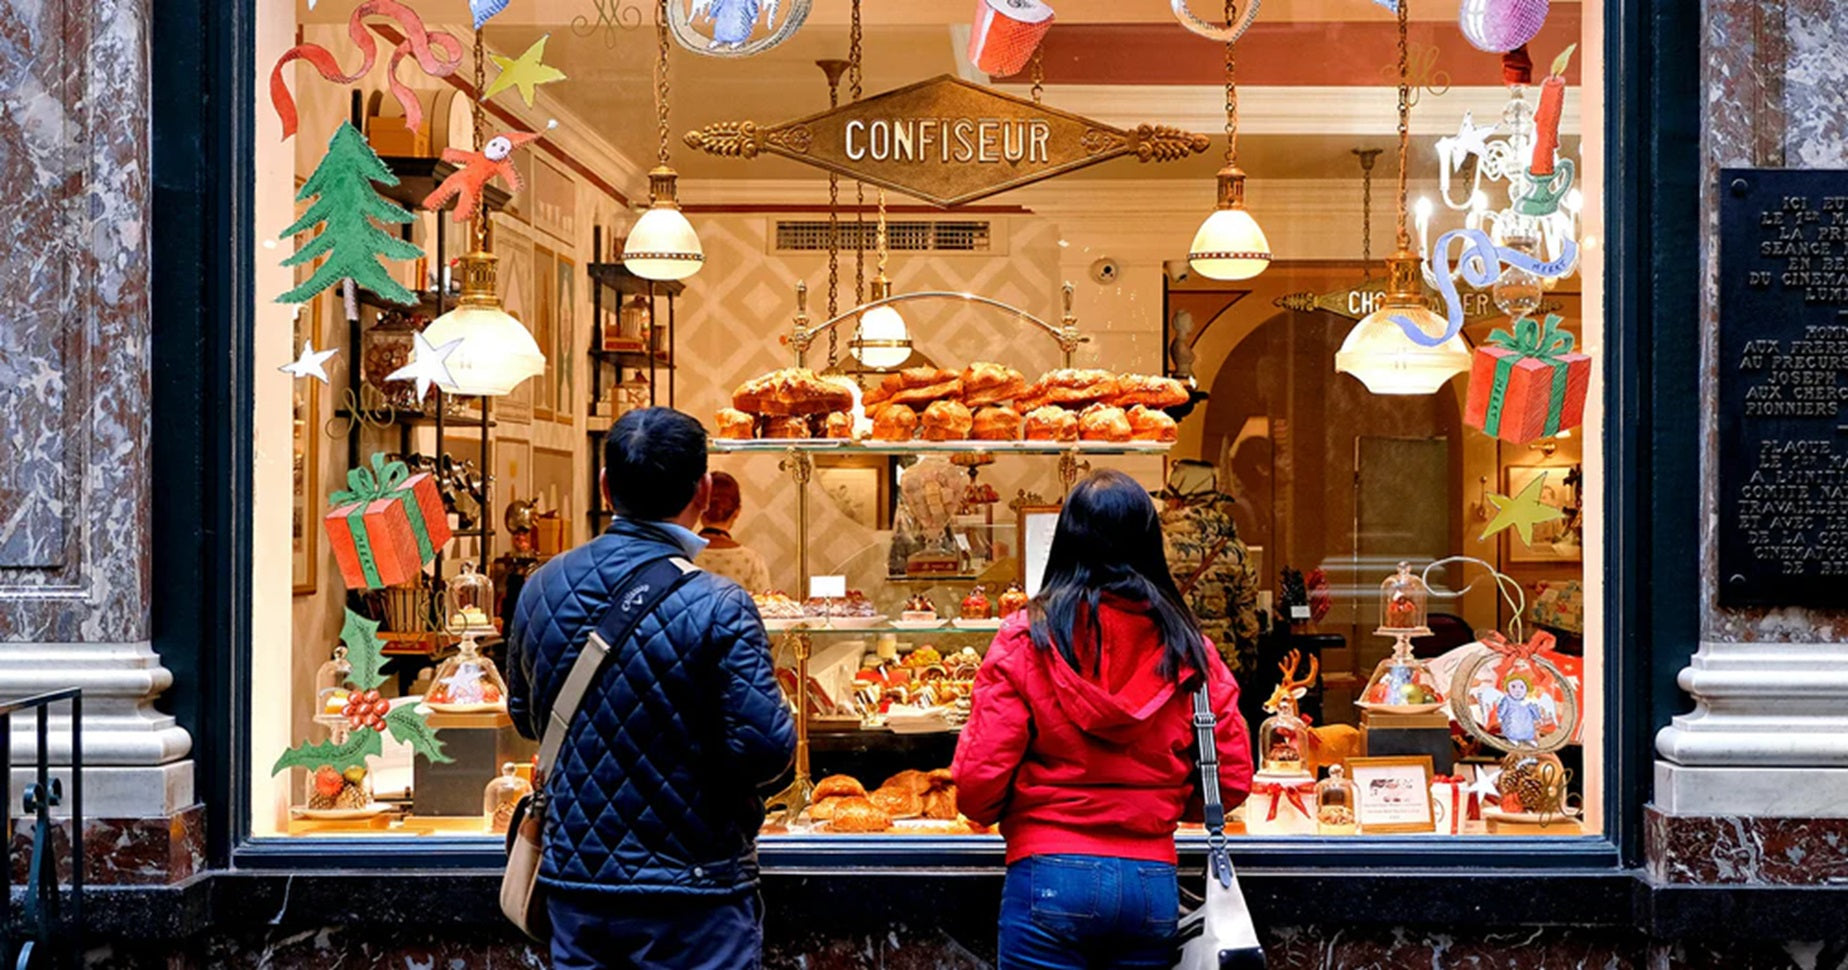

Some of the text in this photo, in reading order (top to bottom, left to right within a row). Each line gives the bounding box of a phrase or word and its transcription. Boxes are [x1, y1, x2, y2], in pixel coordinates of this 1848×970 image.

[845, 118, 1050, 163] CONFISEUR
[1782, 196, 1848, 210] ICI EU
[1761, 211, 1784, 225] LE
[1831, 211, 1848, 225] M
[1779, 227, 1804, 240] LA
[1760, 241, 1831, 255] SEANCE
[1788, 257, 1848, 271] EN BE
[1749, 272, 1771, 285] DU
[1743, 340, 1780, 354] AUX
[1739, 355, 1763, 369] AU
[1767, 371, 1837, 385] JOSEPH
[1745, 386, 1782, 400] AUX
[1745, 402, 1839, 415] PIONNIERS
[1760, 440, 1831, 454] PLAQUE
[1750, 470, 1765, 484] A
[1741, 485, 1809, 498] COMITE
[1738, 515, 1761, 529] ET
[1769, 515, 1814, 529] AVEC
[1748, 530, 1770, 544] DE
[1782, 530, 1806, 544] LA
[1782, 561, 1804, 575] DE
